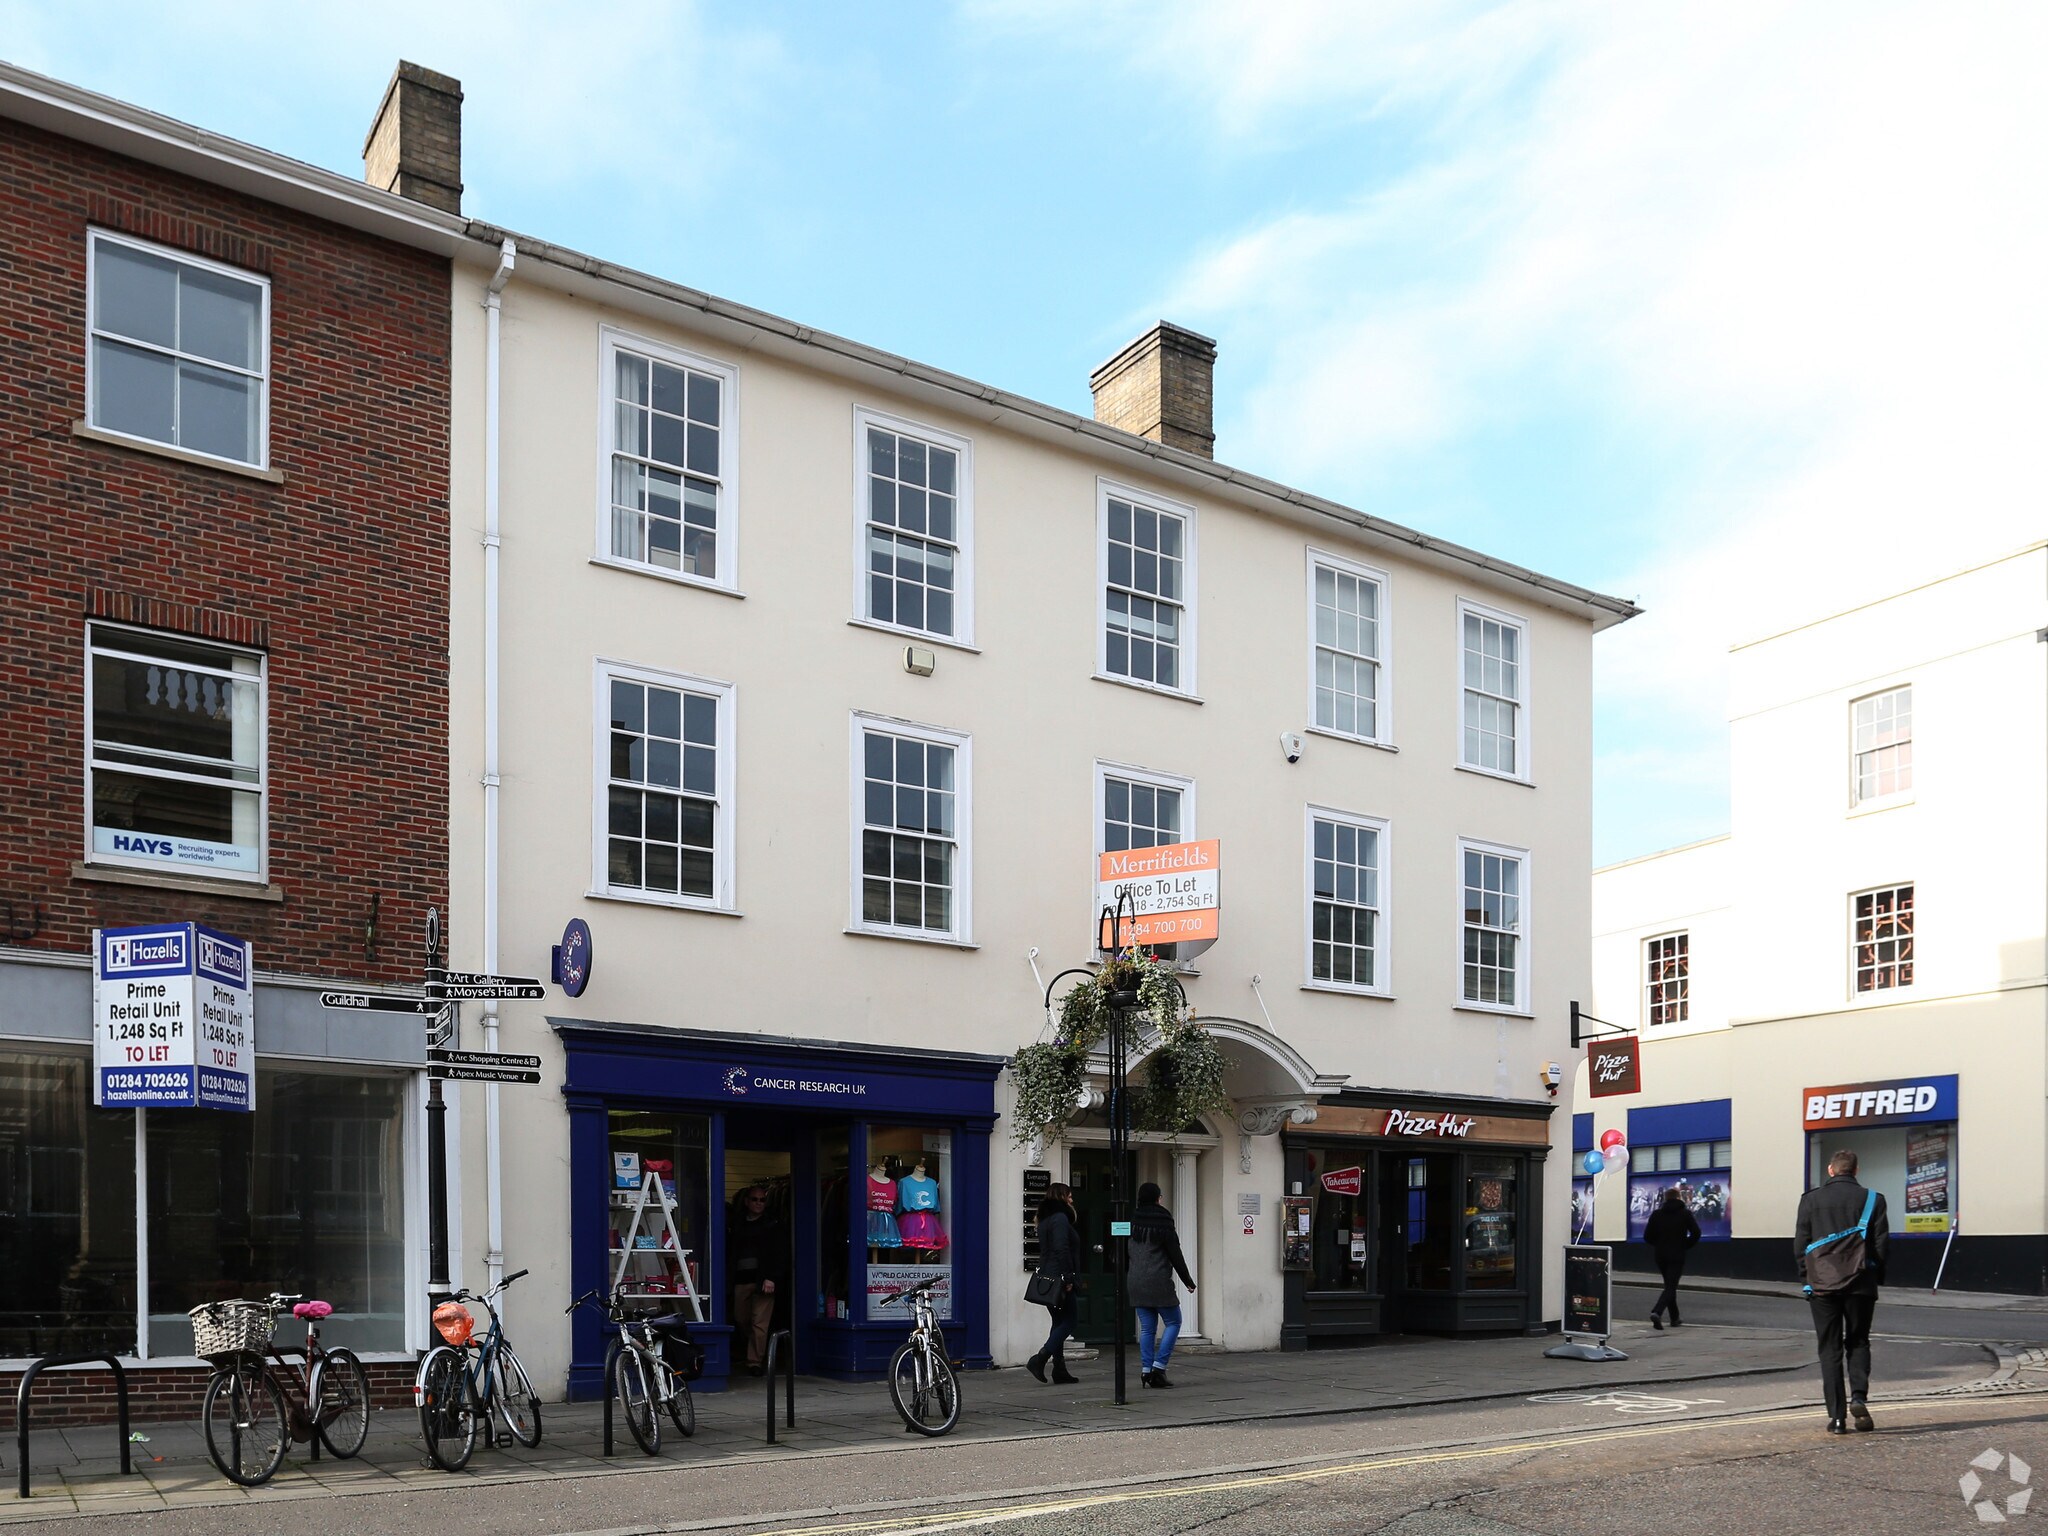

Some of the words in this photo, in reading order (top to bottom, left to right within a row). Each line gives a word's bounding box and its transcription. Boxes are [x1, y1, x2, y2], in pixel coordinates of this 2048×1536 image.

[114, 835, 173, 856] HAYS
[178, 844, 213, 855] Recruiting
[214, 849, 240, 858] experts
[178, 852, 214, 862] worldwide
[1109, 846, 1209, 875] Merrifields
[1114, 883, 1152, 899] Office
[1156, 880, 1170, 895] To
[1175, 877, 1196, 893] Let
[1156, 896, 1184, 911] 2,754
[1187, 894, 1200, 907] Sq
[1203, 893, 1213, 904] Ft
[1119, 923, 1150, 937] 1284
[1154, 921, 1176, 934] 700
[1180, 918, 1202, 931] 700
[132, 939, 180, 961] Hazells
[214, 947, 241, 972] Hazells
[453, 973, 469, 984] Art
[473, 974, 507, 986] Gallery
[127, 983, 166, 998] Prime
[213, 986, 235, 1006] Prime
[454, 987, 496, 999] Moyse's
[498, 986, 518, 997] Hall
[326, 994, 370, 1008] Guildhall
[110, 1003, 149, 1020] Retail
[154, 1001, 181, 1018] Unit
[203, 1003, 226, 1022] Retail
[228, 1010, 242, 1028] Unit
[108, 1024, 145, 1041] 1,248
[150, 1022, 167, 1042] Sq
[172, 1022, 184, 1038] Ft
[202, 1023, 224, 1043] 1,248
[226, 1029, 236, 1048] Sq
[238, 1032, 244, 1048] Ft
[126, 1046, 144, 1062] TO
[149, 1046, 169, 1061] LET
[212, 1048, 224, 1065] TO
[226, 1051, 238, 1068] LET
[469, 1055, 500, 1065] Shopping
[502, 1057, 524, 1065] Centre
[1594, 1054, 1630, 1071] Pizza
[107, 1074, 142, 1088] 01284
[145, 1072, 189, 1087] 702626
[202, 1074, 222, 1090] 01284
[224, 1078, 246, 1094] 702626
[456, 1070, 474, 1078] Apex
[476, 1071, 496, 1079] Music
[498, 1072, 518, 1080] Venue
[1600, 1068, 1626, 1083] Hut
[107, 1089, 188, 1100] hazellsonline.co.uk
[754, 1077, 796, 1090] CANCER
[800, 1080, 850, 1094] RESEARCH
[852, 1085, 866, 1095] UK
[202, 1091, 247, 1106] hazellsonline.co.uk
[1806, 1085, 1938, 1121] BETFRED
[1384, 1109, 1437, 1136] Pizza
[1438, 1113, 1477, 1137] Hut
[1326, 1176, 1358, 1187] Takeaway
